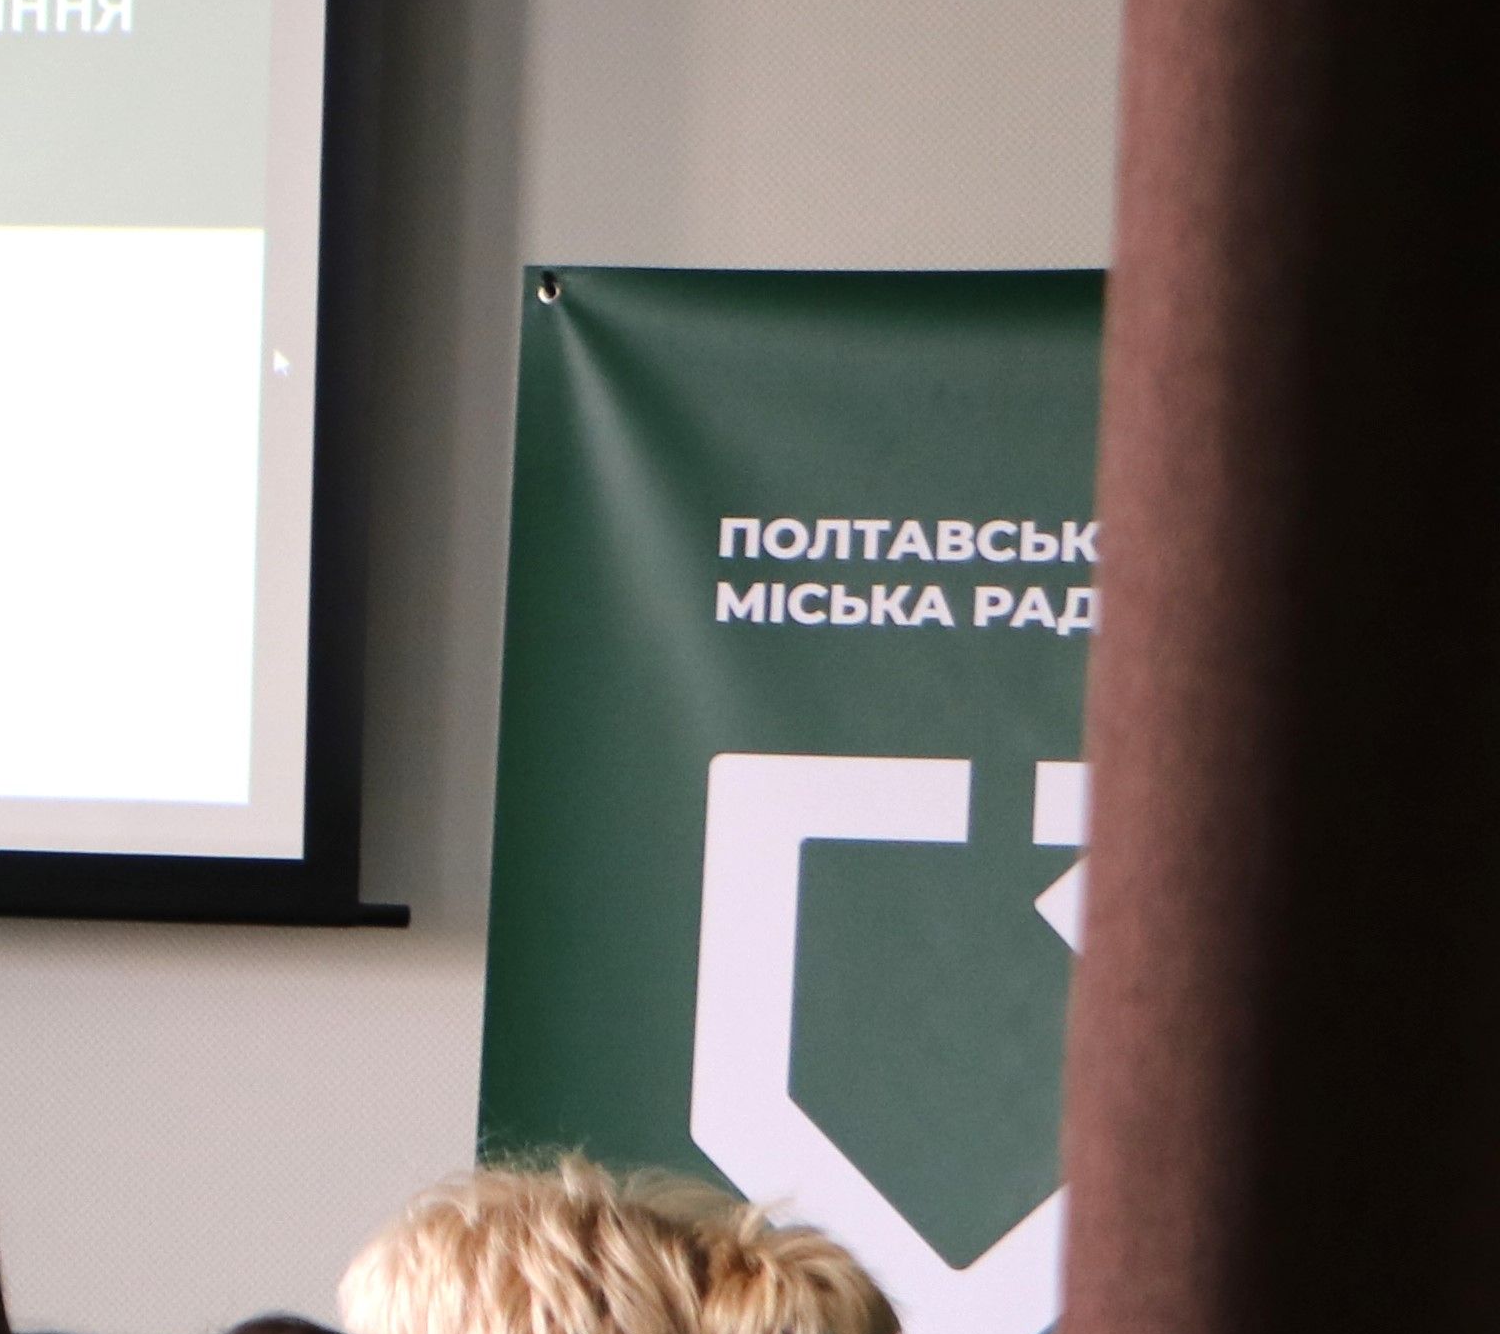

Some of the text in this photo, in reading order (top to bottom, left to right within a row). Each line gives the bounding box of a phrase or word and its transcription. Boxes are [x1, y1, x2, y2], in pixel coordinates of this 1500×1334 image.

[718, 517, 1101, 563] ПОЛТАВСЬК
[715, 581, 1101, 636] МІСЬКА РАД
